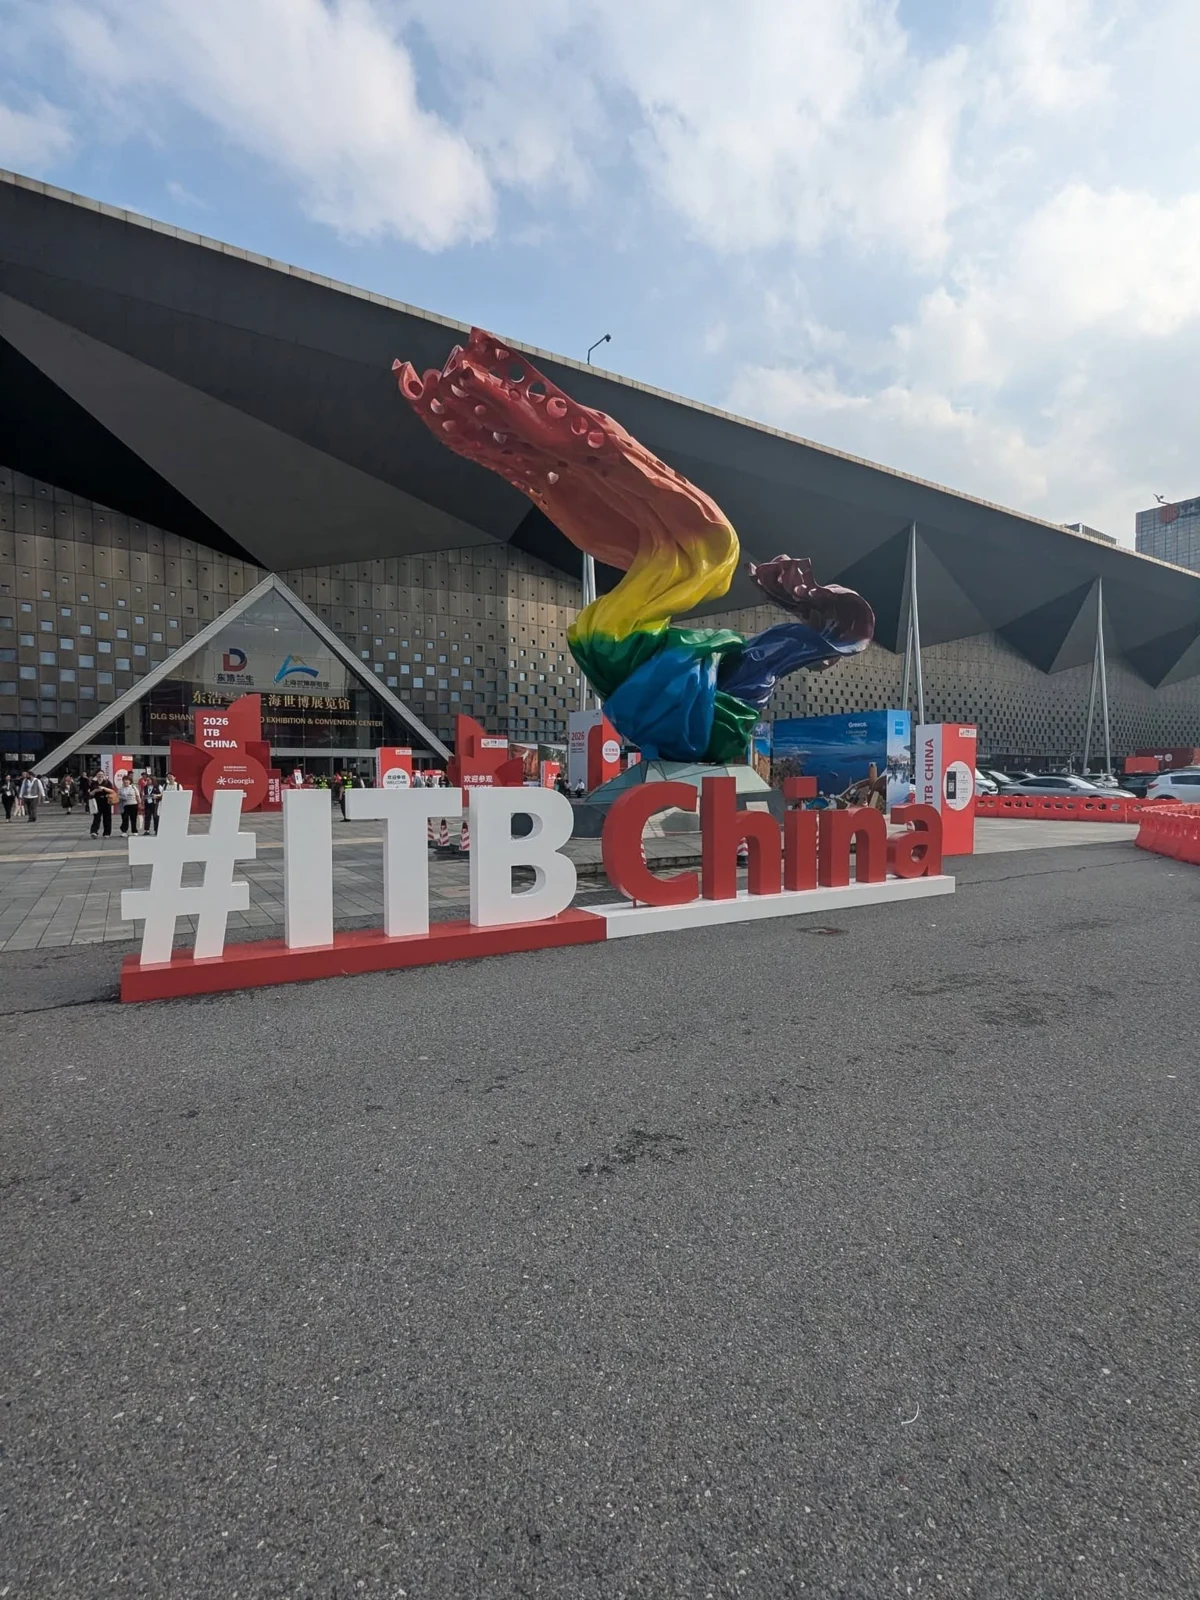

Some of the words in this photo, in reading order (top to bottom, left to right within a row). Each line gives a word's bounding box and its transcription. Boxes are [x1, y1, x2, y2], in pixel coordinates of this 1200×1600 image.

[203, 717, 229, 726] 2026
[266, 717, 306, 725] EXHIBITION
[315, 718, 358, 726] CONVENTION
[203, 728, 220, 737] ITB
[203, 740, 238, 748] CHINA
[924, 738, 934, 781] CHINA
[227, 777, 255, 785] Georgia
[463, 775, 493, 783] 欢迎参观
[924, 785, 934, 804] ITB
[121, 787, 577, 965] #ITB
[602, 776, 944, 906] China
